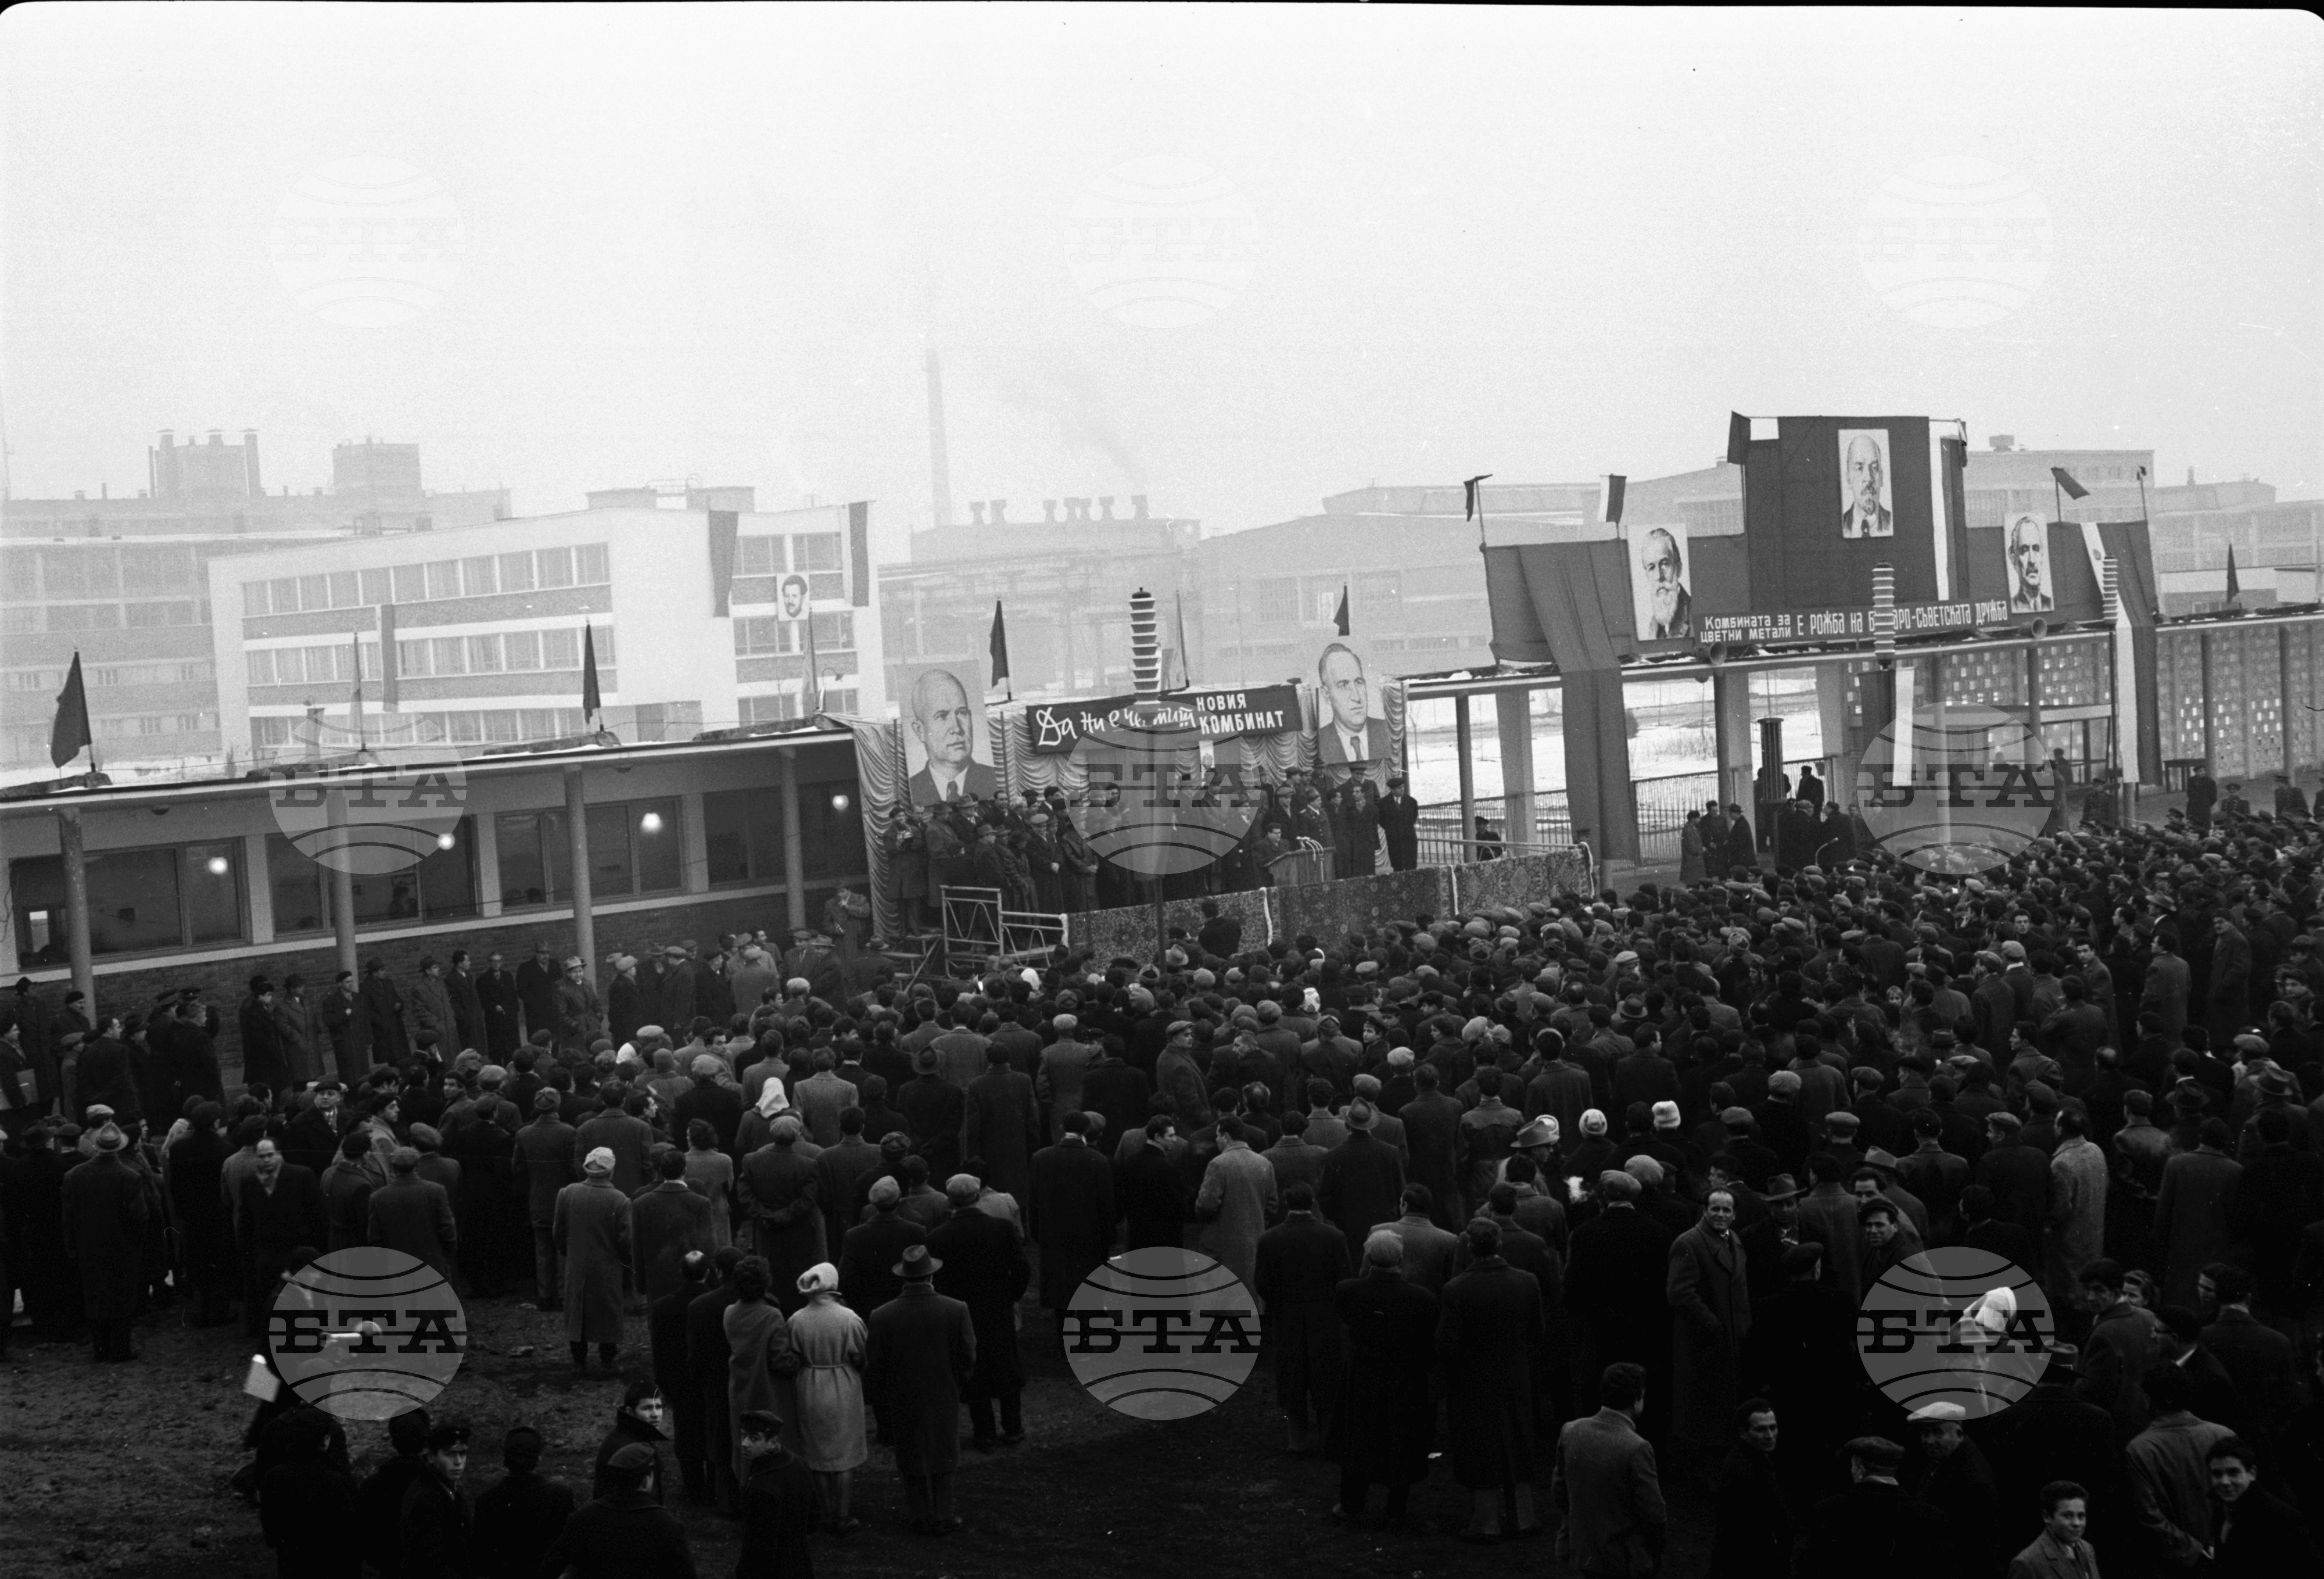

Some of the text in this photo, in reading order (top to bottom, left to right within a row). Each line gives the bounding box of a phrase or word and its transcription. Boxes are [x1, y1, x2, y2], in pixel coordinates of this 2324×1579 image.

[1797, 615, 1804, 635] Е
[1196, 693, 1246, 711] НОВИЯ
[1036, 707, 1077, 746] Да
[1109, 710, 1120, 727] е
[1199, 711, 1283, 735] КОМБИНАТ
